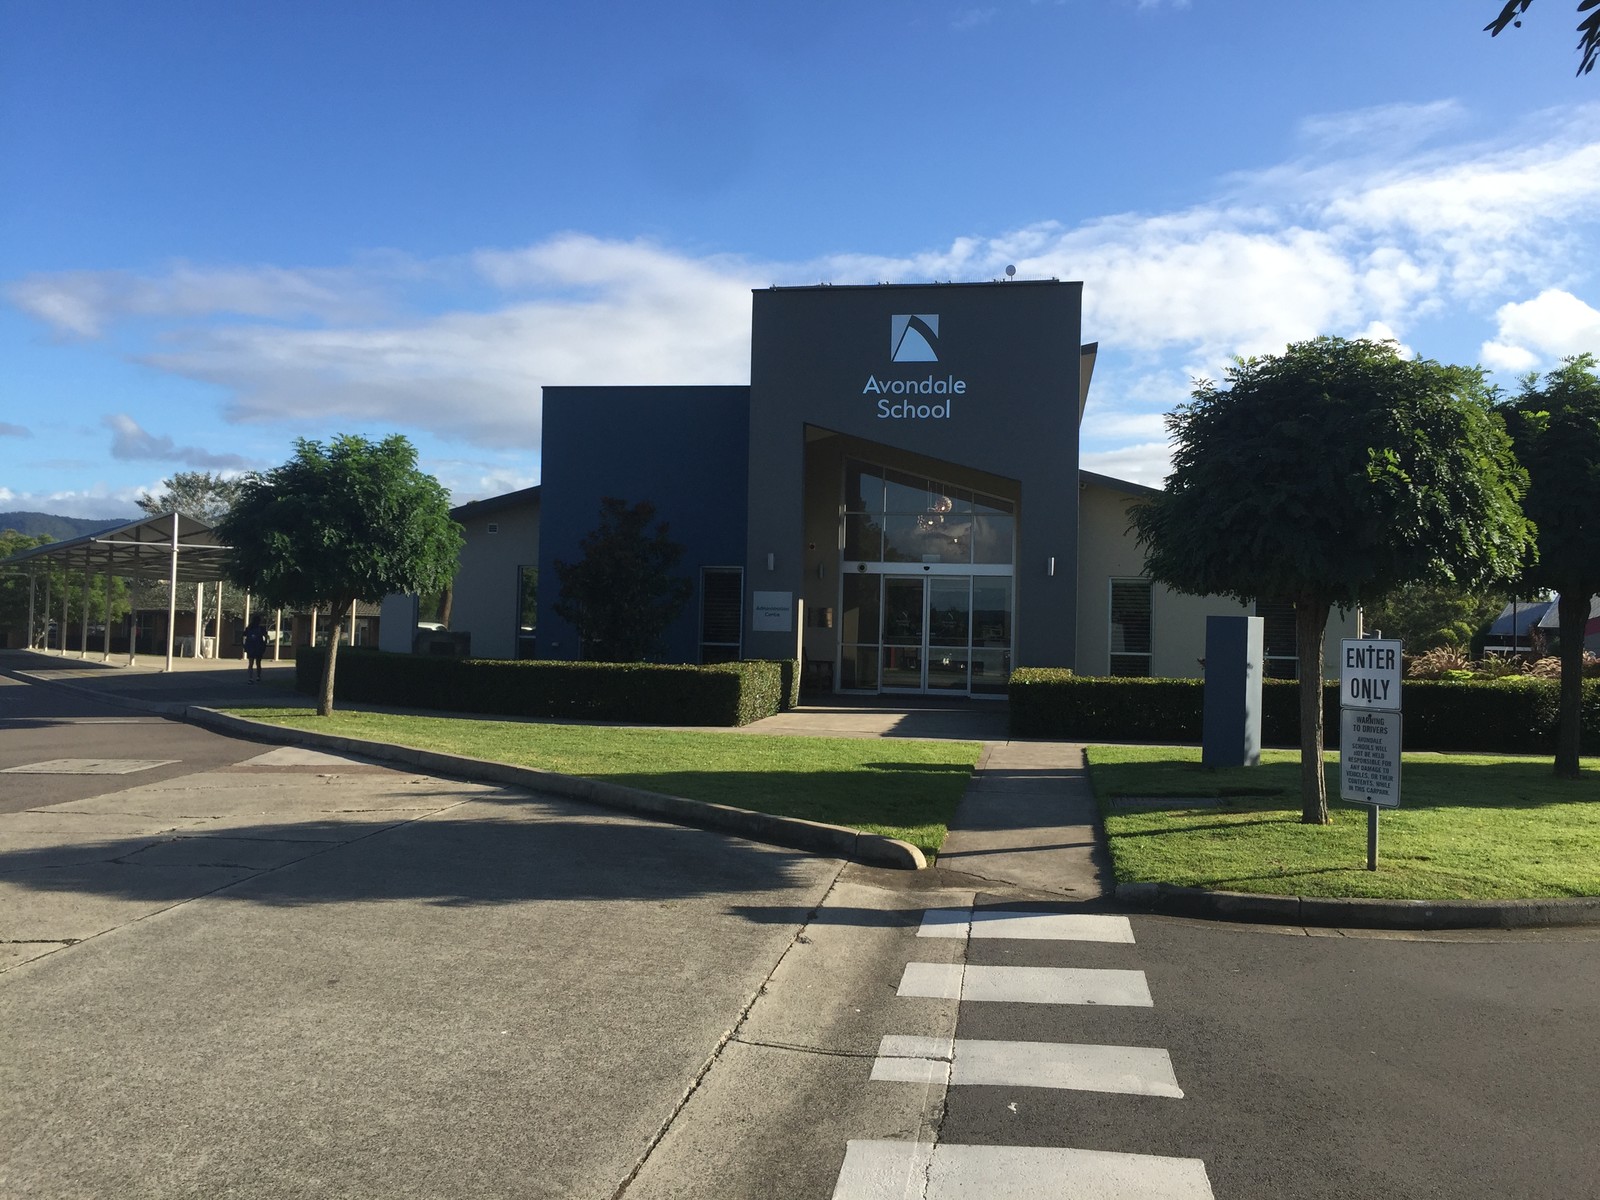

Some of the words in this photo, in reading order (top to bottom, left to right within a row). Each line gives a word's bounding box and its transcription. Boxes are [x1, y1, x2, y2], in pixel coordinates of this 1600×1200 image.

[862, 374, 967, 394] Avondale
[877, 398, 951, 419] School
[1346, 647, 1395, 670] ENTER
[1351, 677, 1391, 700] ONLY
[1356, 716, 1385, 726] WARNING
[1362, 725, 1388, 734] DRIVERS
[1357, 736, 1382, 744] AVONDALE
[1352, 743, 1374, 751] SCHOOLS
[1348, 756, 1380, 766] RESPONSIBLE
[1361, 765, 1382, 773] DAMAGE
